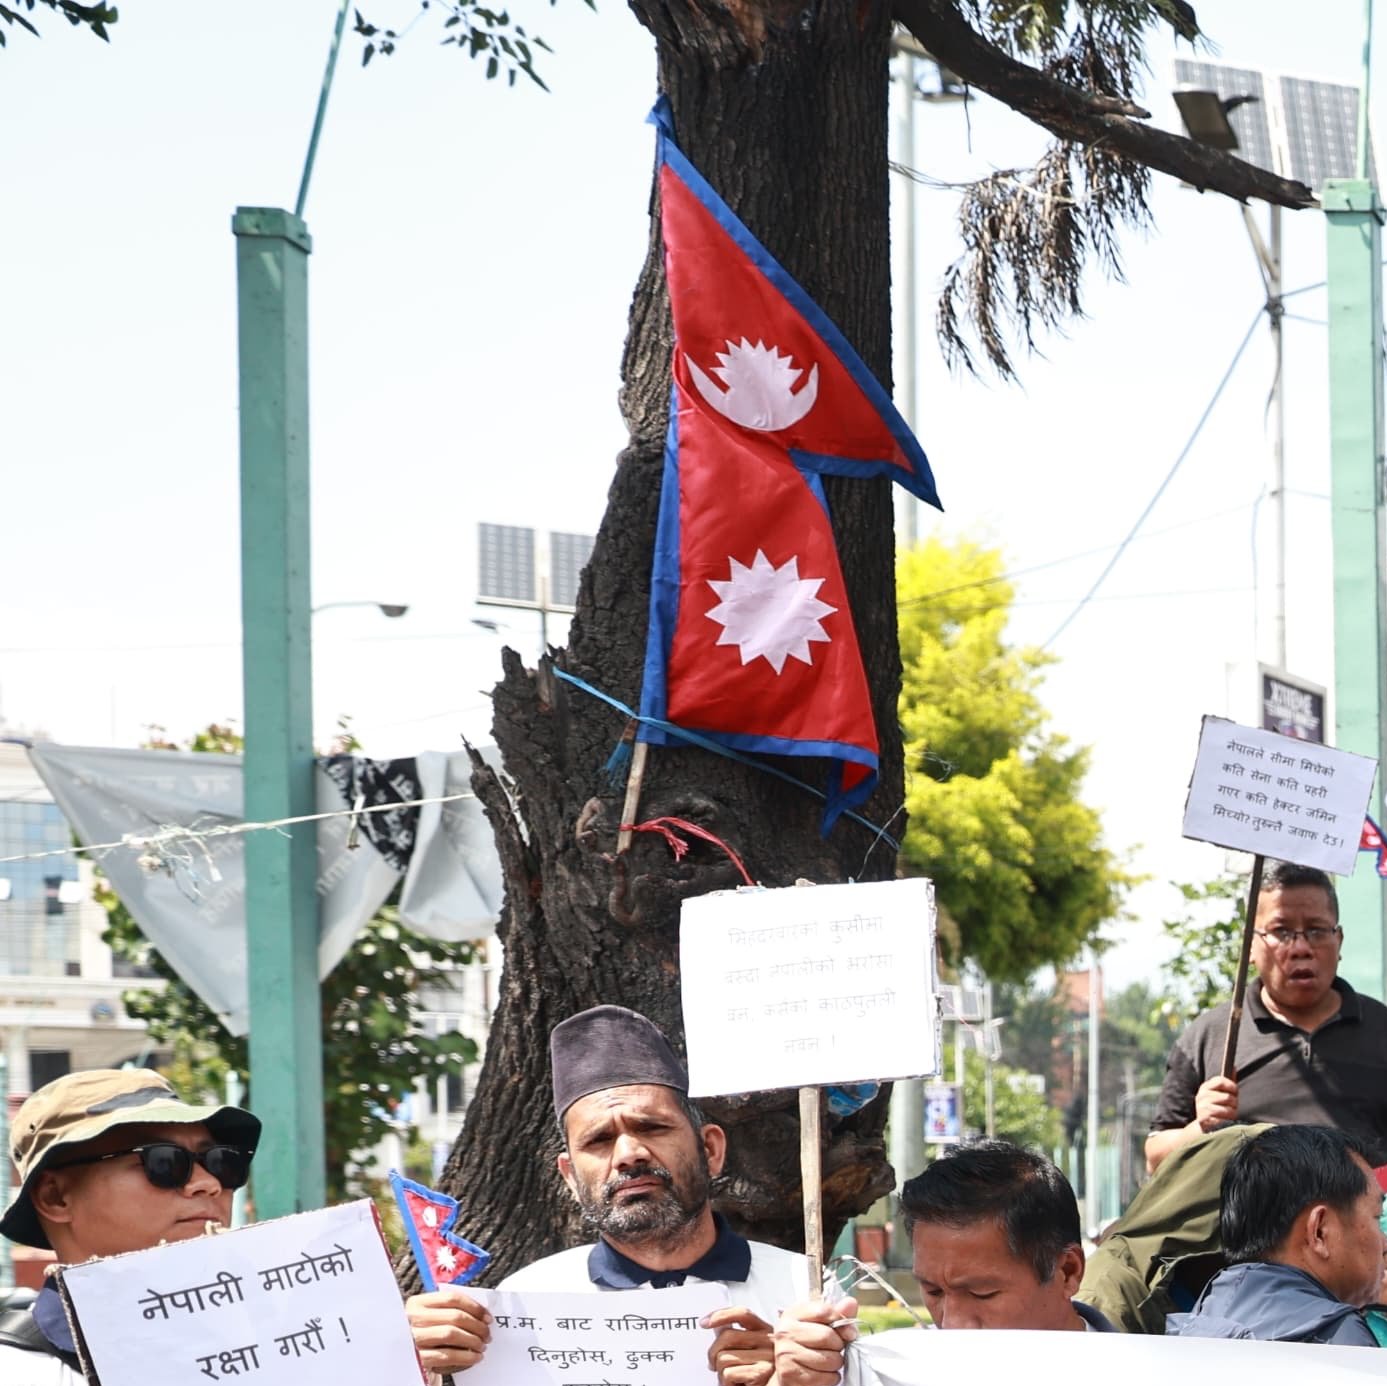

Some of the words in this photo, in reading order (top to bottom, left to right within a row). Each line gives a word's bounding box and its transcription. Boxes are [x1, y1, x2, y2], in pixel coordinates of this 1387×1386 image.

[138, 1271, 245, 1321] नेपाली
[258, 1243, 354, 1292] माटोको
[494, 1315, 543, 1330] प्र.म.
[556, 1316, 593, 1331] बाट
[604, 1314, 699, 1331] राजिनामा
[196, 1344, 260, 1381] रक्षा
[337, 1317, 351, 1344] !
[527, 1348, 613, 1370] दिनुहोस्,
[626, 1350, 675, 1370] ढुक्क
